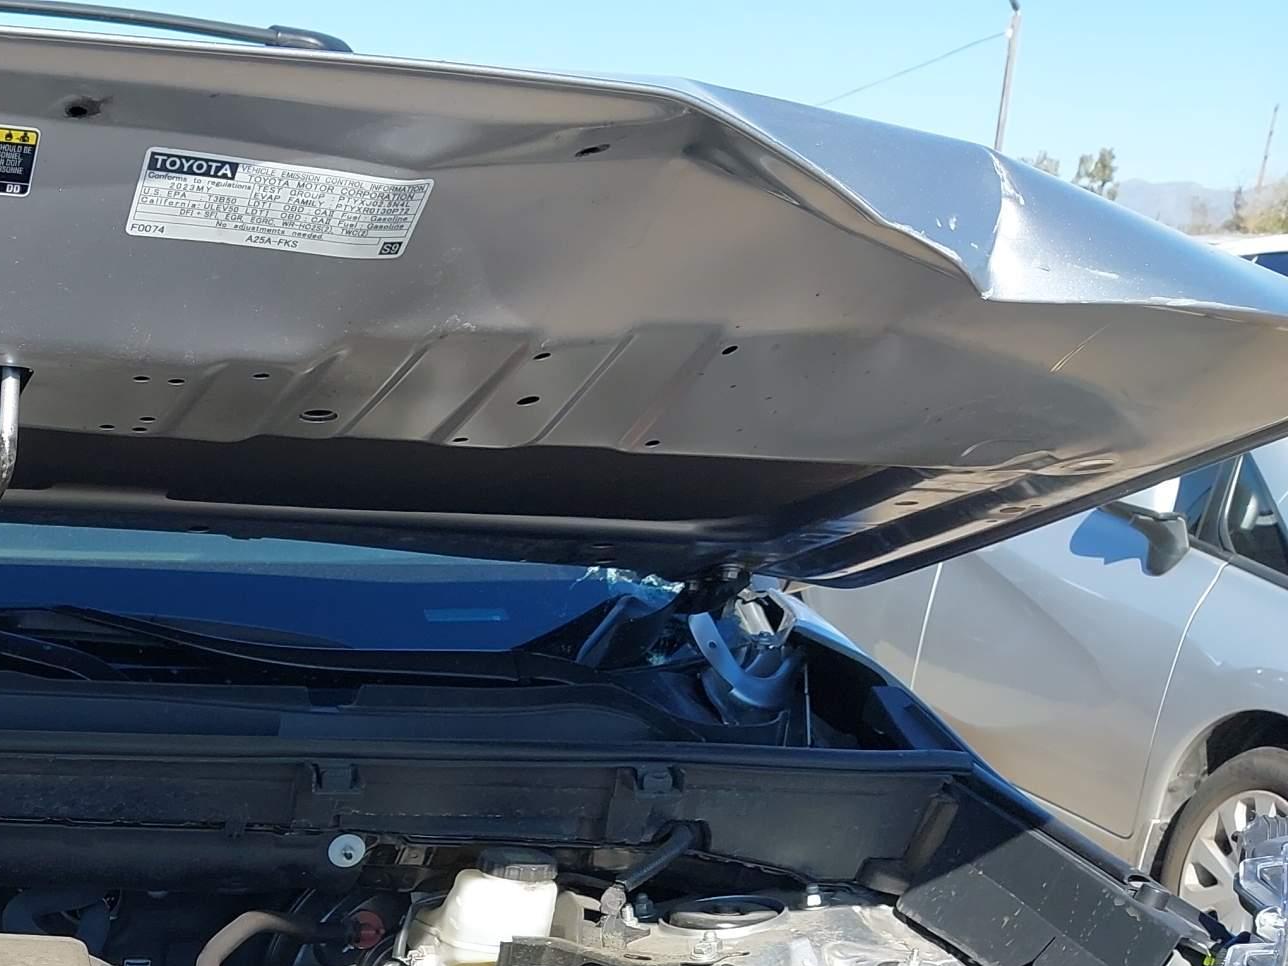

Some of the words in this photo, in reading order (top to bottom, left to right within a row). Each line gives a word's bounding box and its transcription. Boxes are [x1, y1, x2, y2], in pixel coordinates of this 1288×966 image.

[153, 155, 235, 177] TOYOTA
[148, 171, 187, 181] Conforms
[207, 180, 251, 189] regulations
[241, 165, 277, 176] VEHICLE
[281, 171, 321, 181] EMISSION
[325, 177, 363, 187] CONTROL
[6, 184, 20, 193] DD
[169, 182, 212, 192] 2023MY
[248, 176, 290, 186] TOYOTA
[296, 182, 334, 192] MOTOR
[340, 188, 414, 200] CORPORATION
[289, 190, 325, 199] GROUP
[287, 197, 324, 206] FAMILY
[204, 203, 239, 212] ULEV50
[131, 224, 164, 232] F0074
[234, 224, 285, 234] adjustments
[245, 235, 298, 247] A25A-FKS
[381, 243, 399, 253] S9
